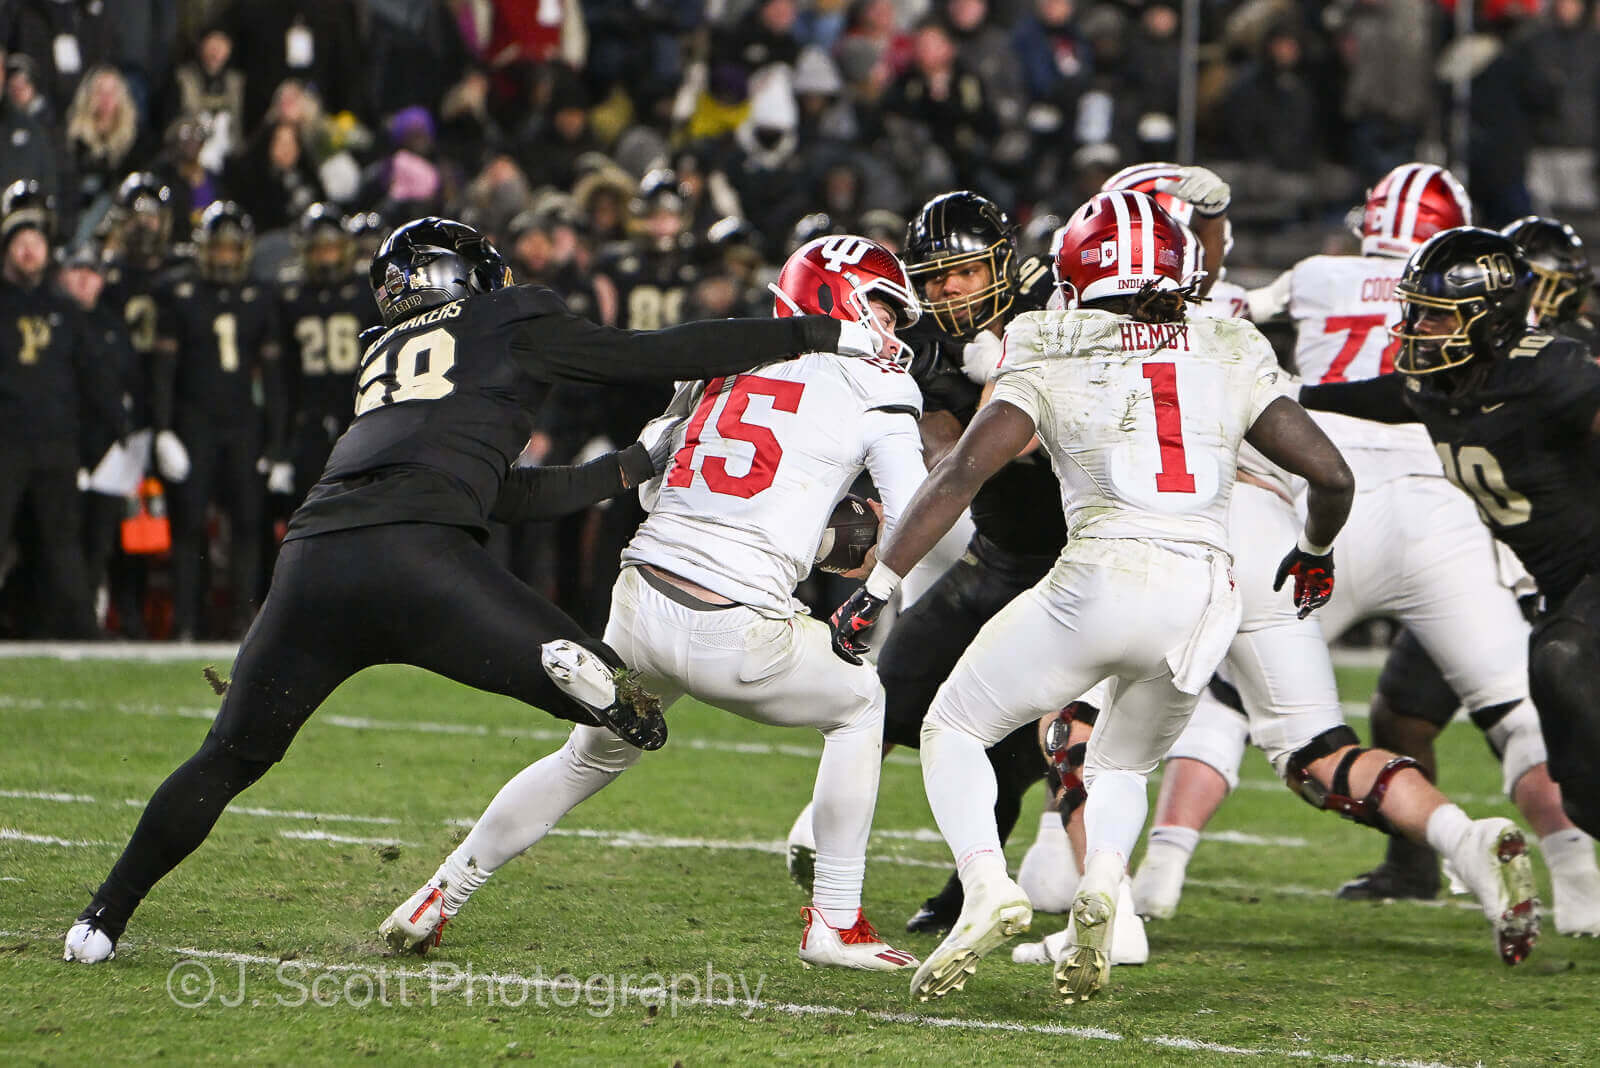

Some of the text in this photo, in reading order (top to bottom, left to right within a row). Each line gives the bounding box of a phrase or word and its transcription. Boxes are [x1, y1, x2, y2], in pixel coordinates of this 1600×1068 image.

[1476, 253, 1515, 291] 10
[213, 313, 240, 373] 1
[295, 314, 361, 375] 26
[1118, 323, 1190, 352] HEMBY
[667, 374, 805, 499] 15
[1142, 362, 1196, 493] 1
